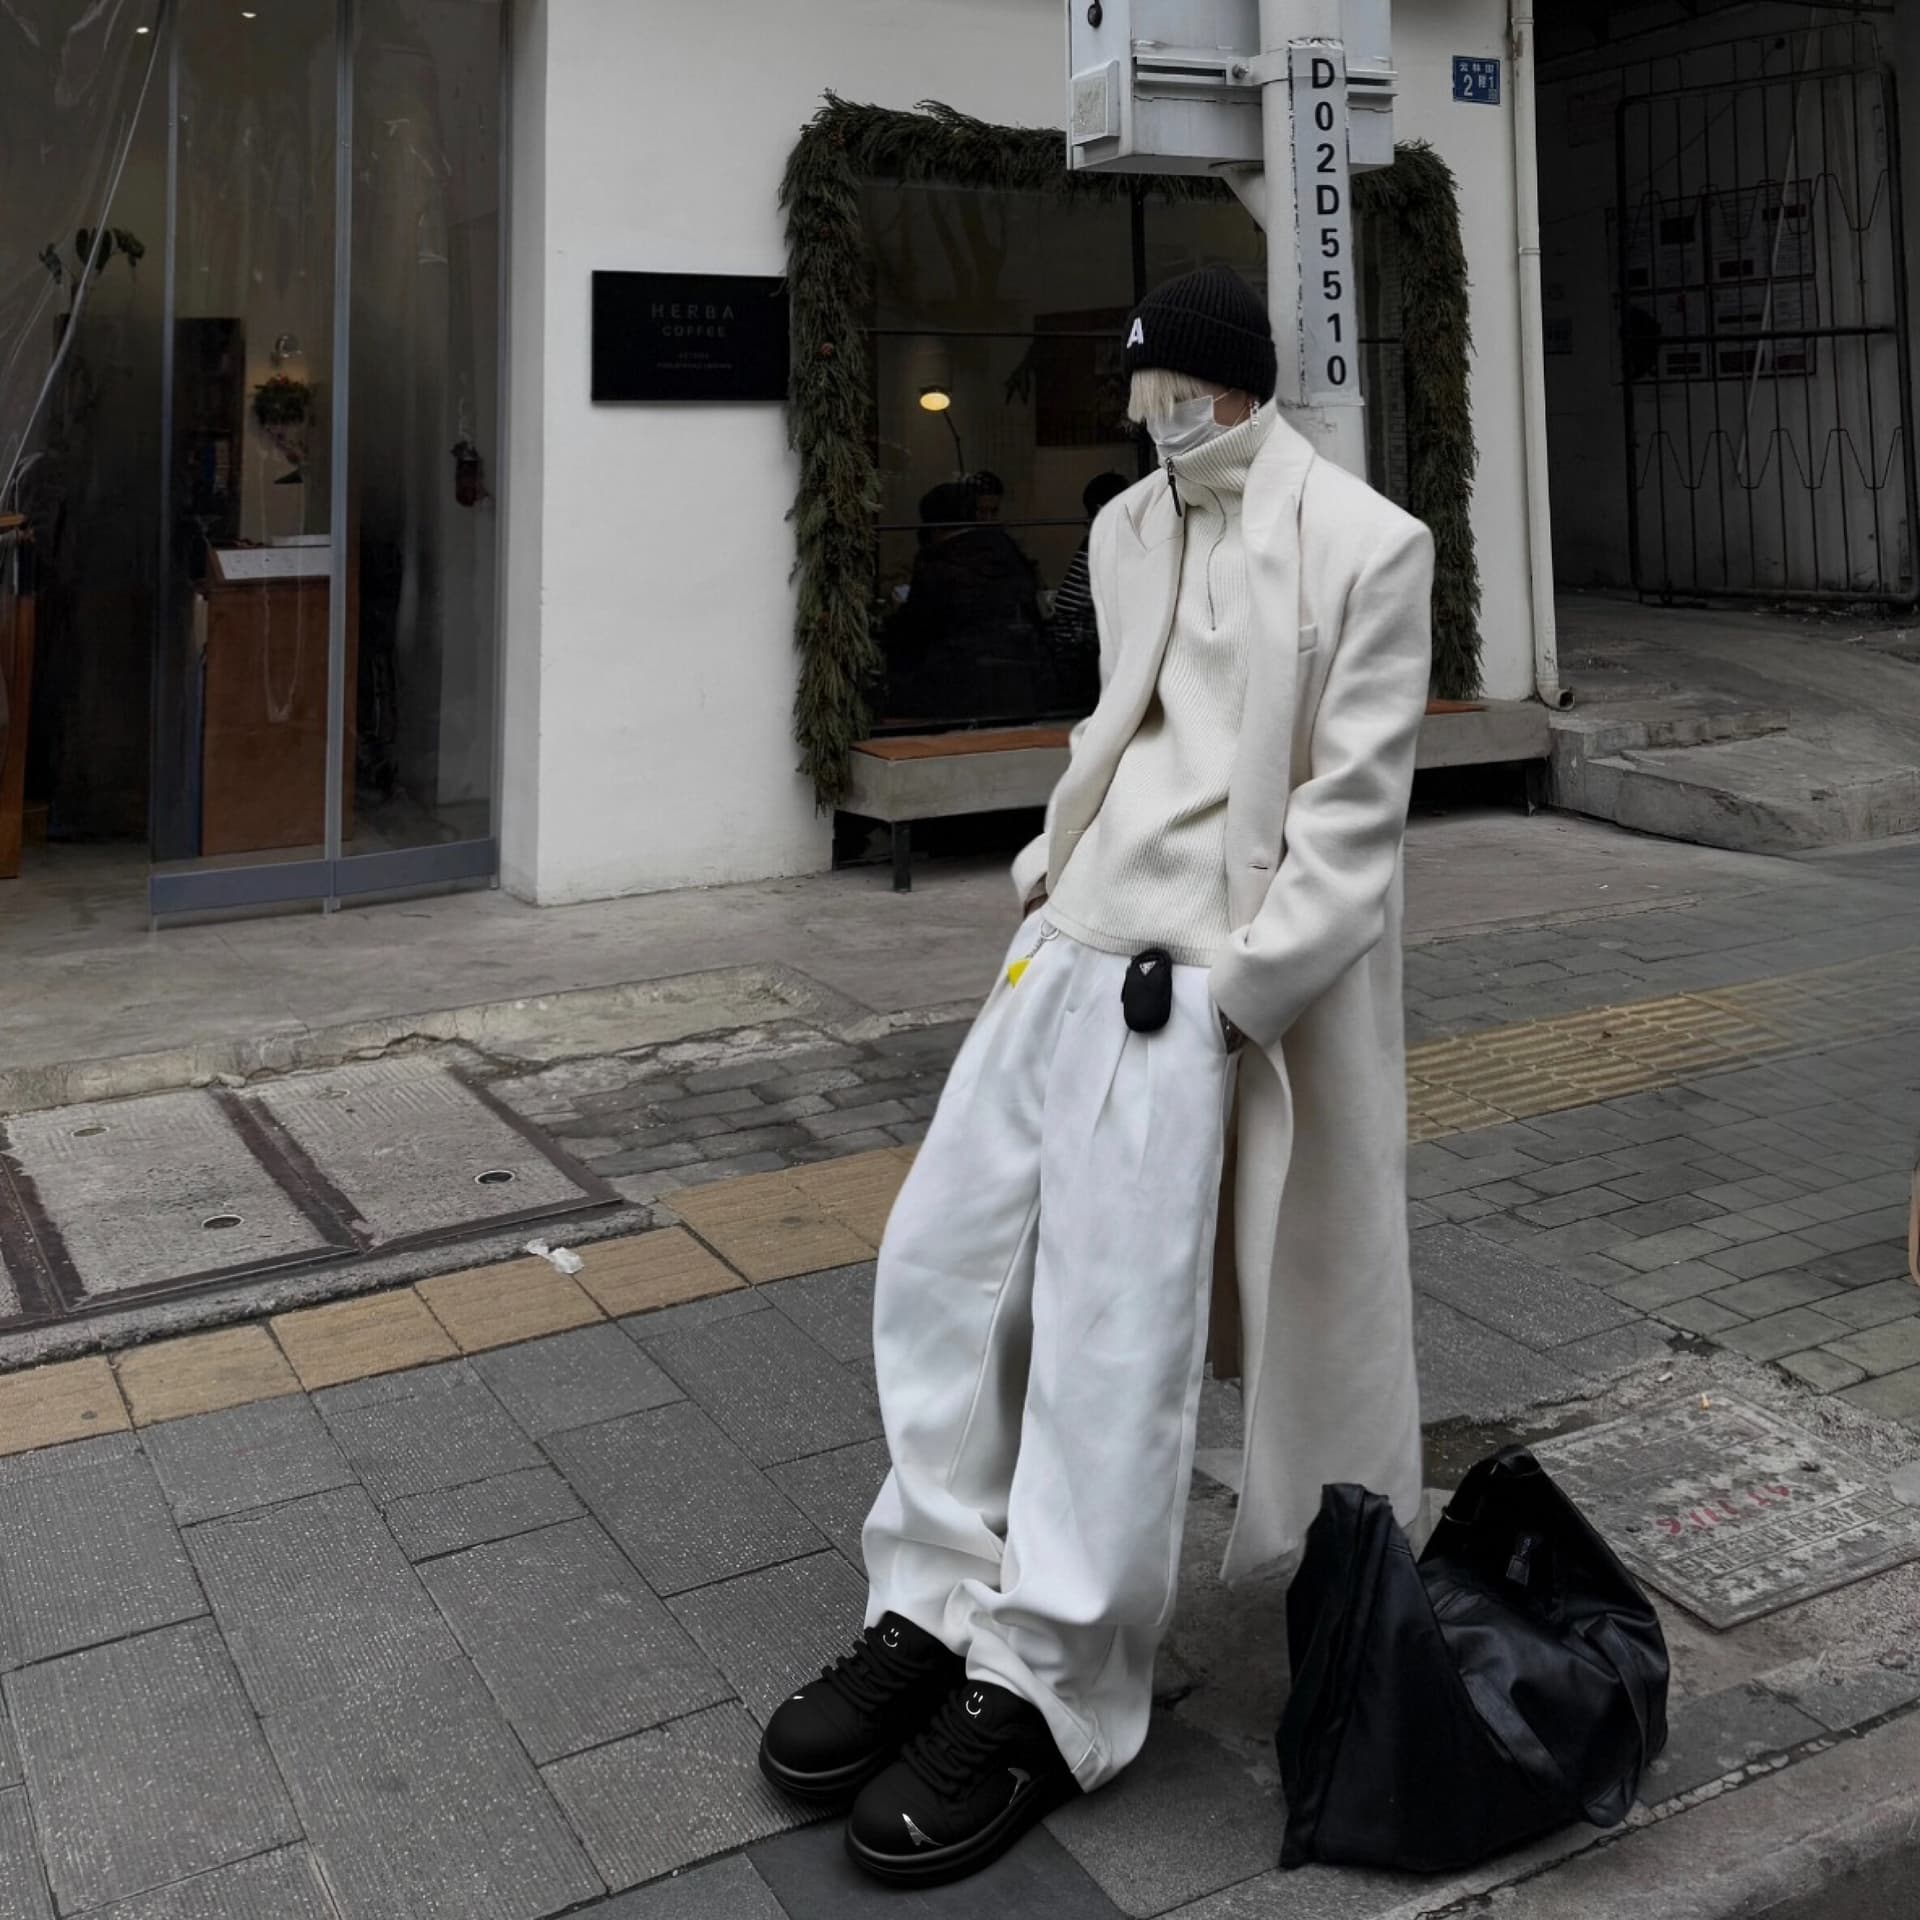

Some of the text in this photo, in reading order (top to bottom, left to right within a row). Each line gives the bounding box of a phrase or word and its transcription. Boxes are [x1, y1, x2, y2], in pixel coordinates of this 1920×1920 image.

[1463, 74, 1473, 96] 2
[1311, 58, 1347, 386] D02D5510
[651, 303, 734, 320] HERBA
[662, 325, 726, 337] COFFEE
[1126, 317, 1145, 349] A
